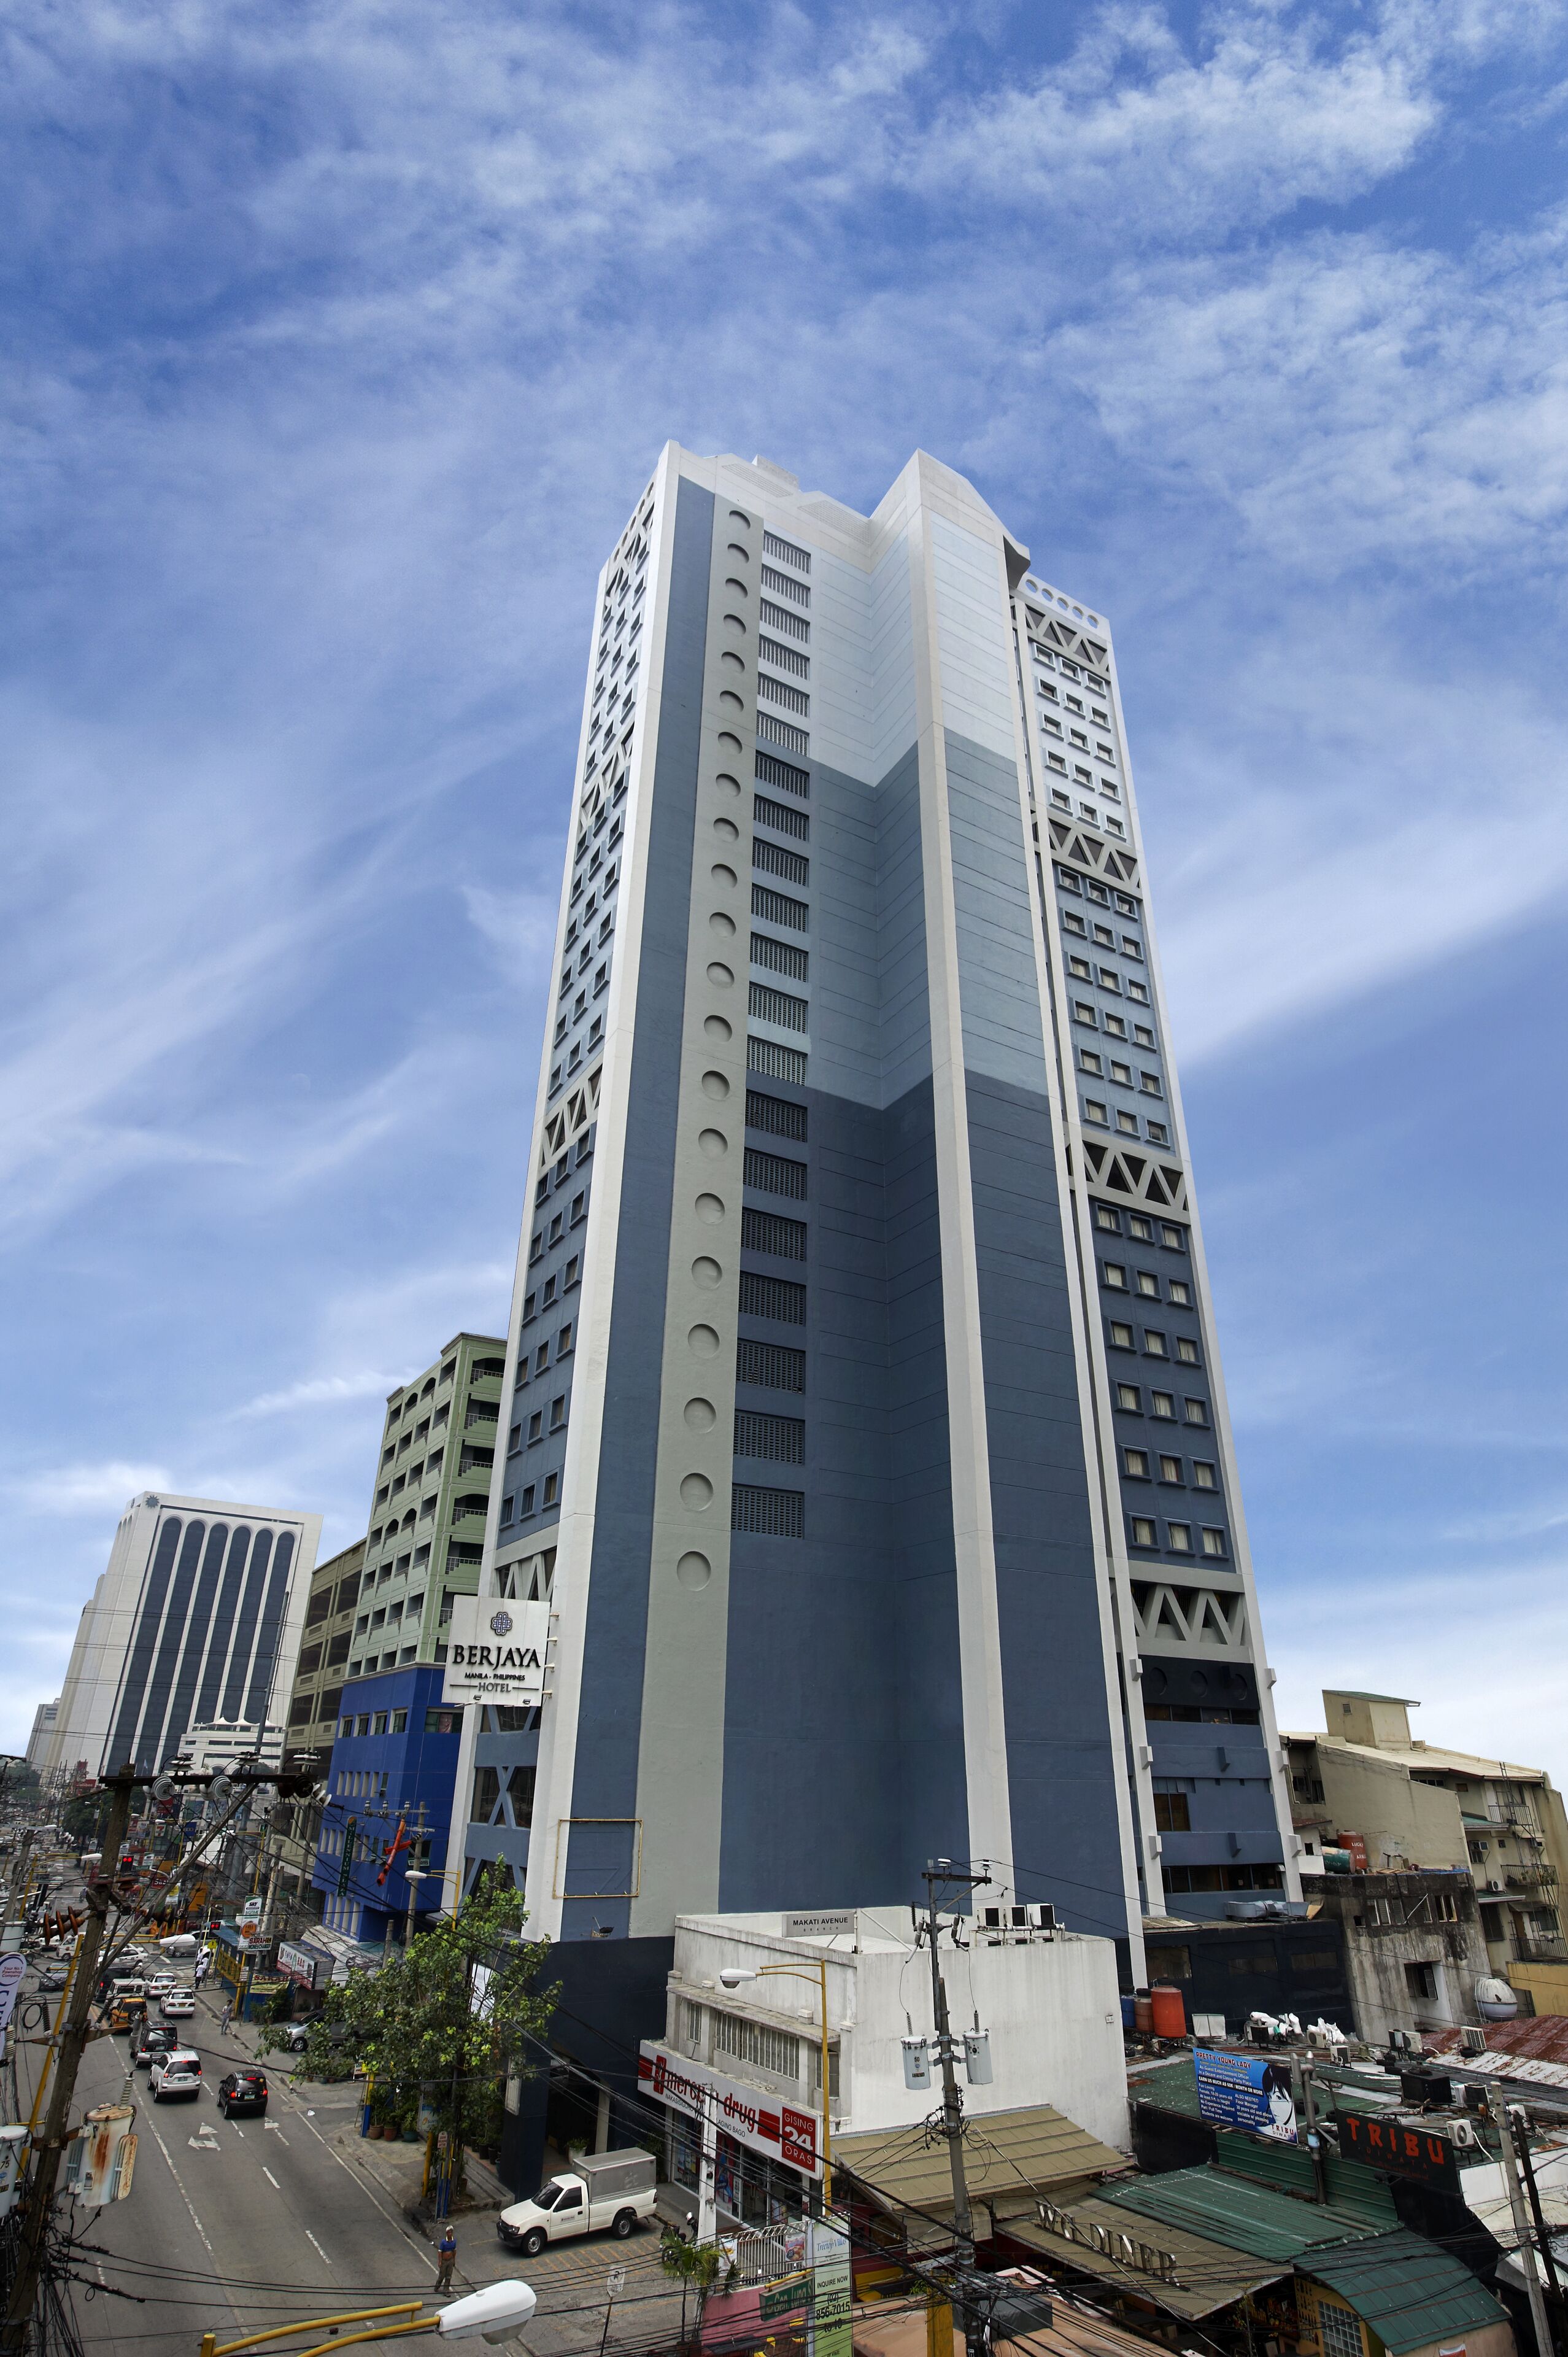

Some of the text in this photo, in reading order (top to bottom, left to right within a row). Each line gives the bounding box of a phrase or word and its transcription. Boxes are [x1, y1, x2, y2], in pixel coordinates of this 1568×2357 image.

[452, 1644, 541, 1670] BERJAYA
[478, 1682, 511, 1692] HOTEL
[1196, 2052, 1215, 2061] PRETTY
[1218, 2056, 1235, 2065] YOUNG
[724, 2093, 755, 2133] drug
[732, 2126, 746, 2137] BAGO
[784, 2113, 813, 2132] GISING
[1271, 2124, 1294, 2135] TRIBU
[784, 2126, 813, 2151] 24
[1346, 2118, 1444, 2164] TRIBU
[785, 2146, 812, 2164] ORAS
[1366, 2146, 1427, 2170] DIWATA
[1, 2160, 10, 2169] 75
[816, 2238, 847, 2253] Treetop Villas
[1090, 2223, 1180, 2286] DINER
[817, 2275, 848, 2288] INQUIRE NOW
[827, 2293, 839, 2305] (02)
[816, 2301, 850, 2320] 856-7015
